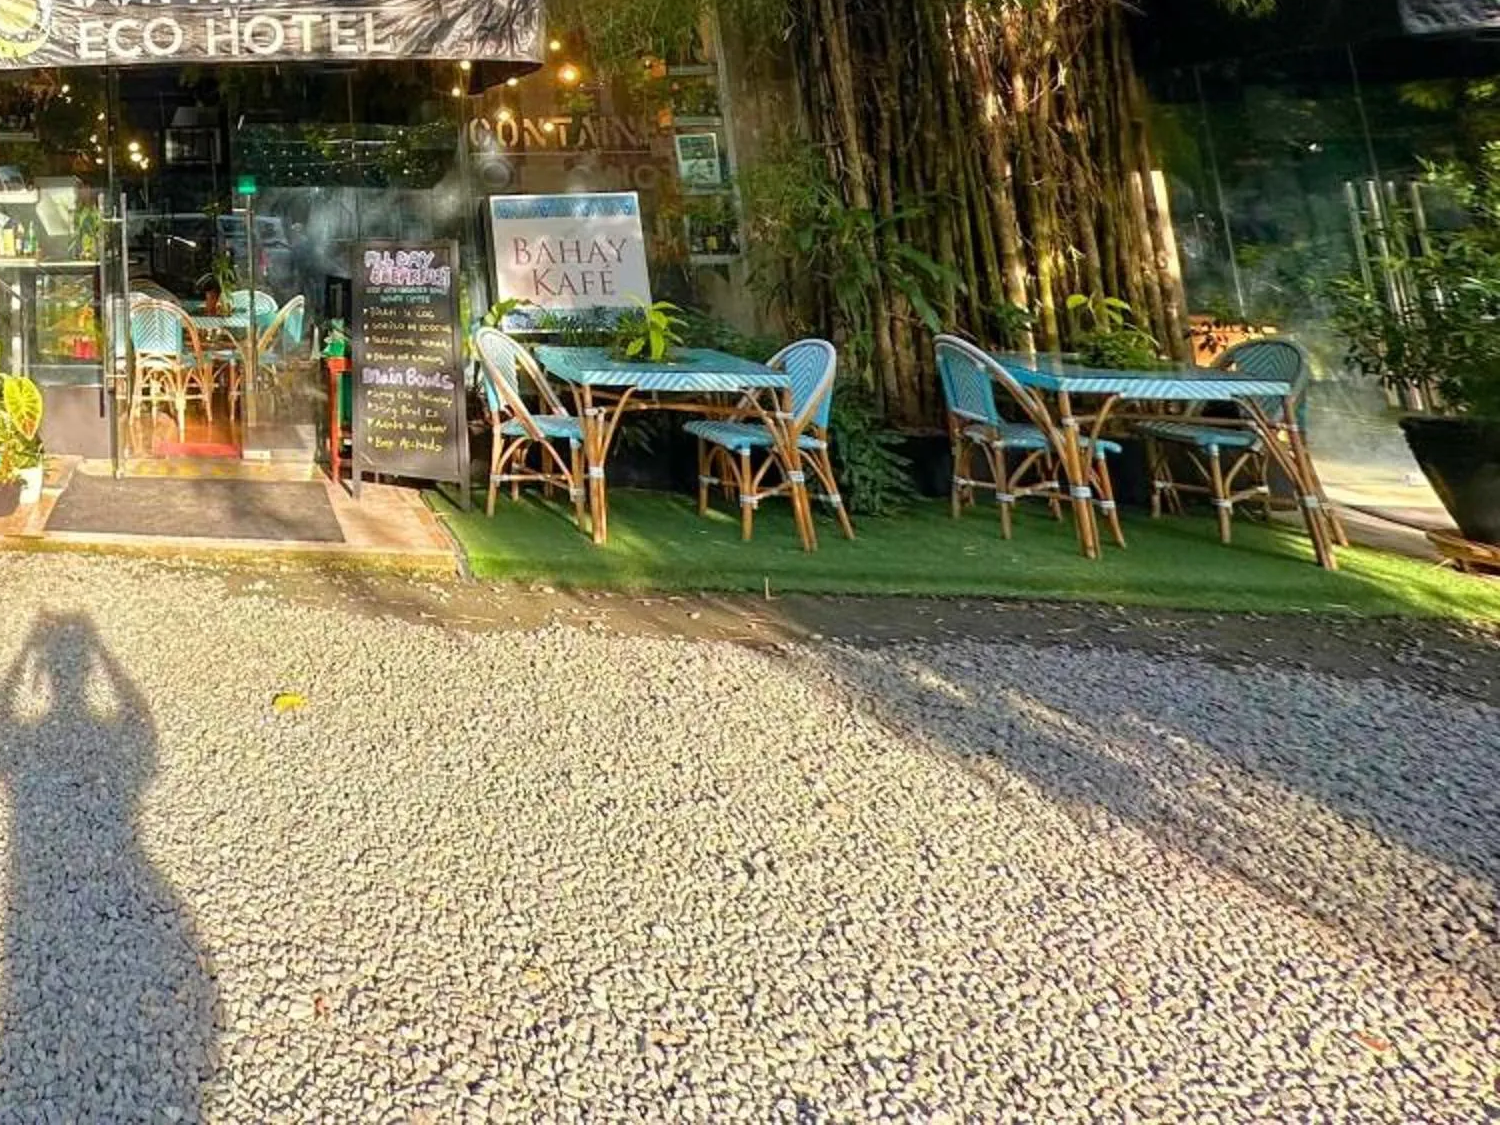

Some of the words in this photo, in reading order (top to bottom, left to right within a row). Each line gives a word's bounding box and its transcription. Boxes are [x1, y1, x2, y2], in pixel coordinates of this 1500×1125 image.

[77, 17, 183, 59] ECO
[206, 12, 393, 56] HOTEL
[513, 237, 627, 265] BAHAY
[532, 264, 614, 296] KAFÉ
[362, 367, 404, 385] Main
